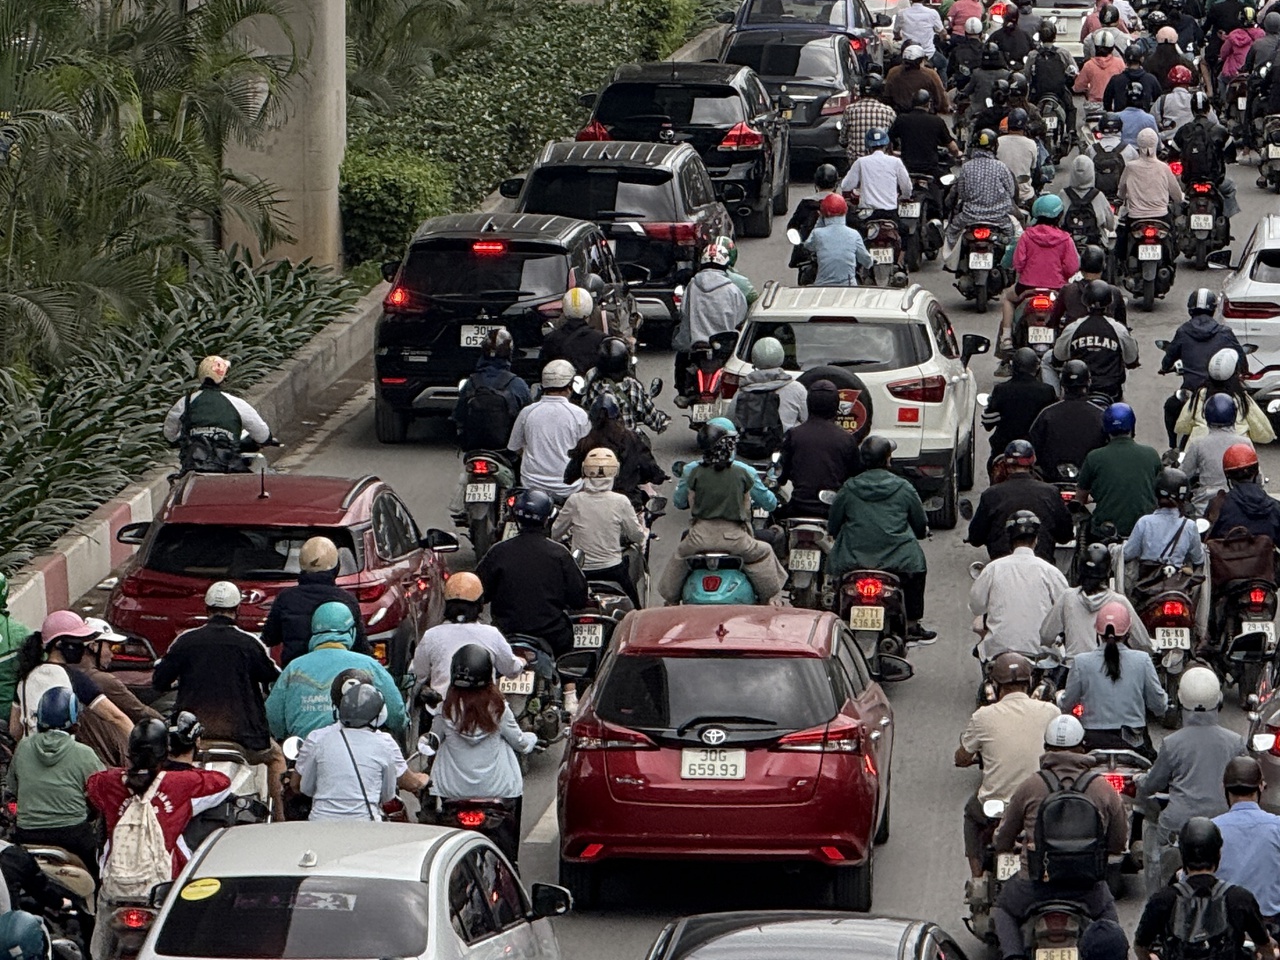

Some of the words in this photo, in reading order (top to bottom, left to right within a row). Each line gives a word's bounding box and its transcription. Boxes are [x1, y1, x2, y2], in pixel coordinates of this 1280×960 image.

[1071, 336, 1118, 351] TEELAB
[701, 749, 727, 761] 30G
[688, 763, 738, 777] 659.93
